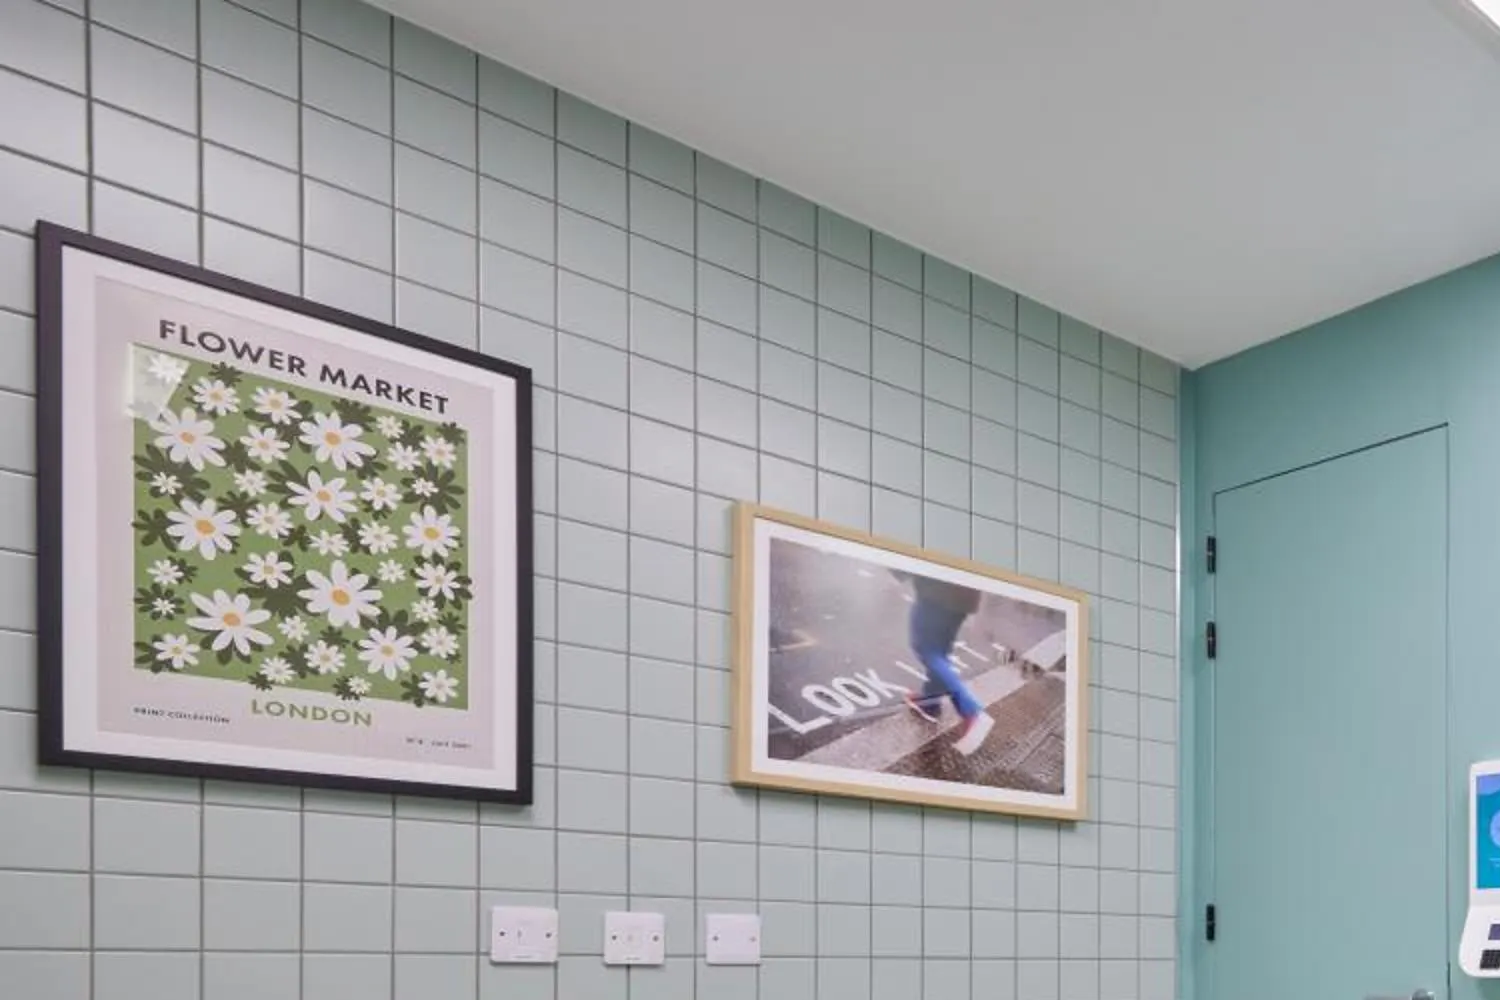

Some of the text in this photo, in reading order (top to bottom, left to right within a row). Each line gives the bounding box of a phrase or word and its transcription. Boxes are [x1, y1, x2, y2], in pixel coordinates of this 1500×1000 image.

[160, 319, 449, 414] FLOWER MARKET
[251, 699, 373, 728] LONDON
[768, 668, 912, 734] LOOK
